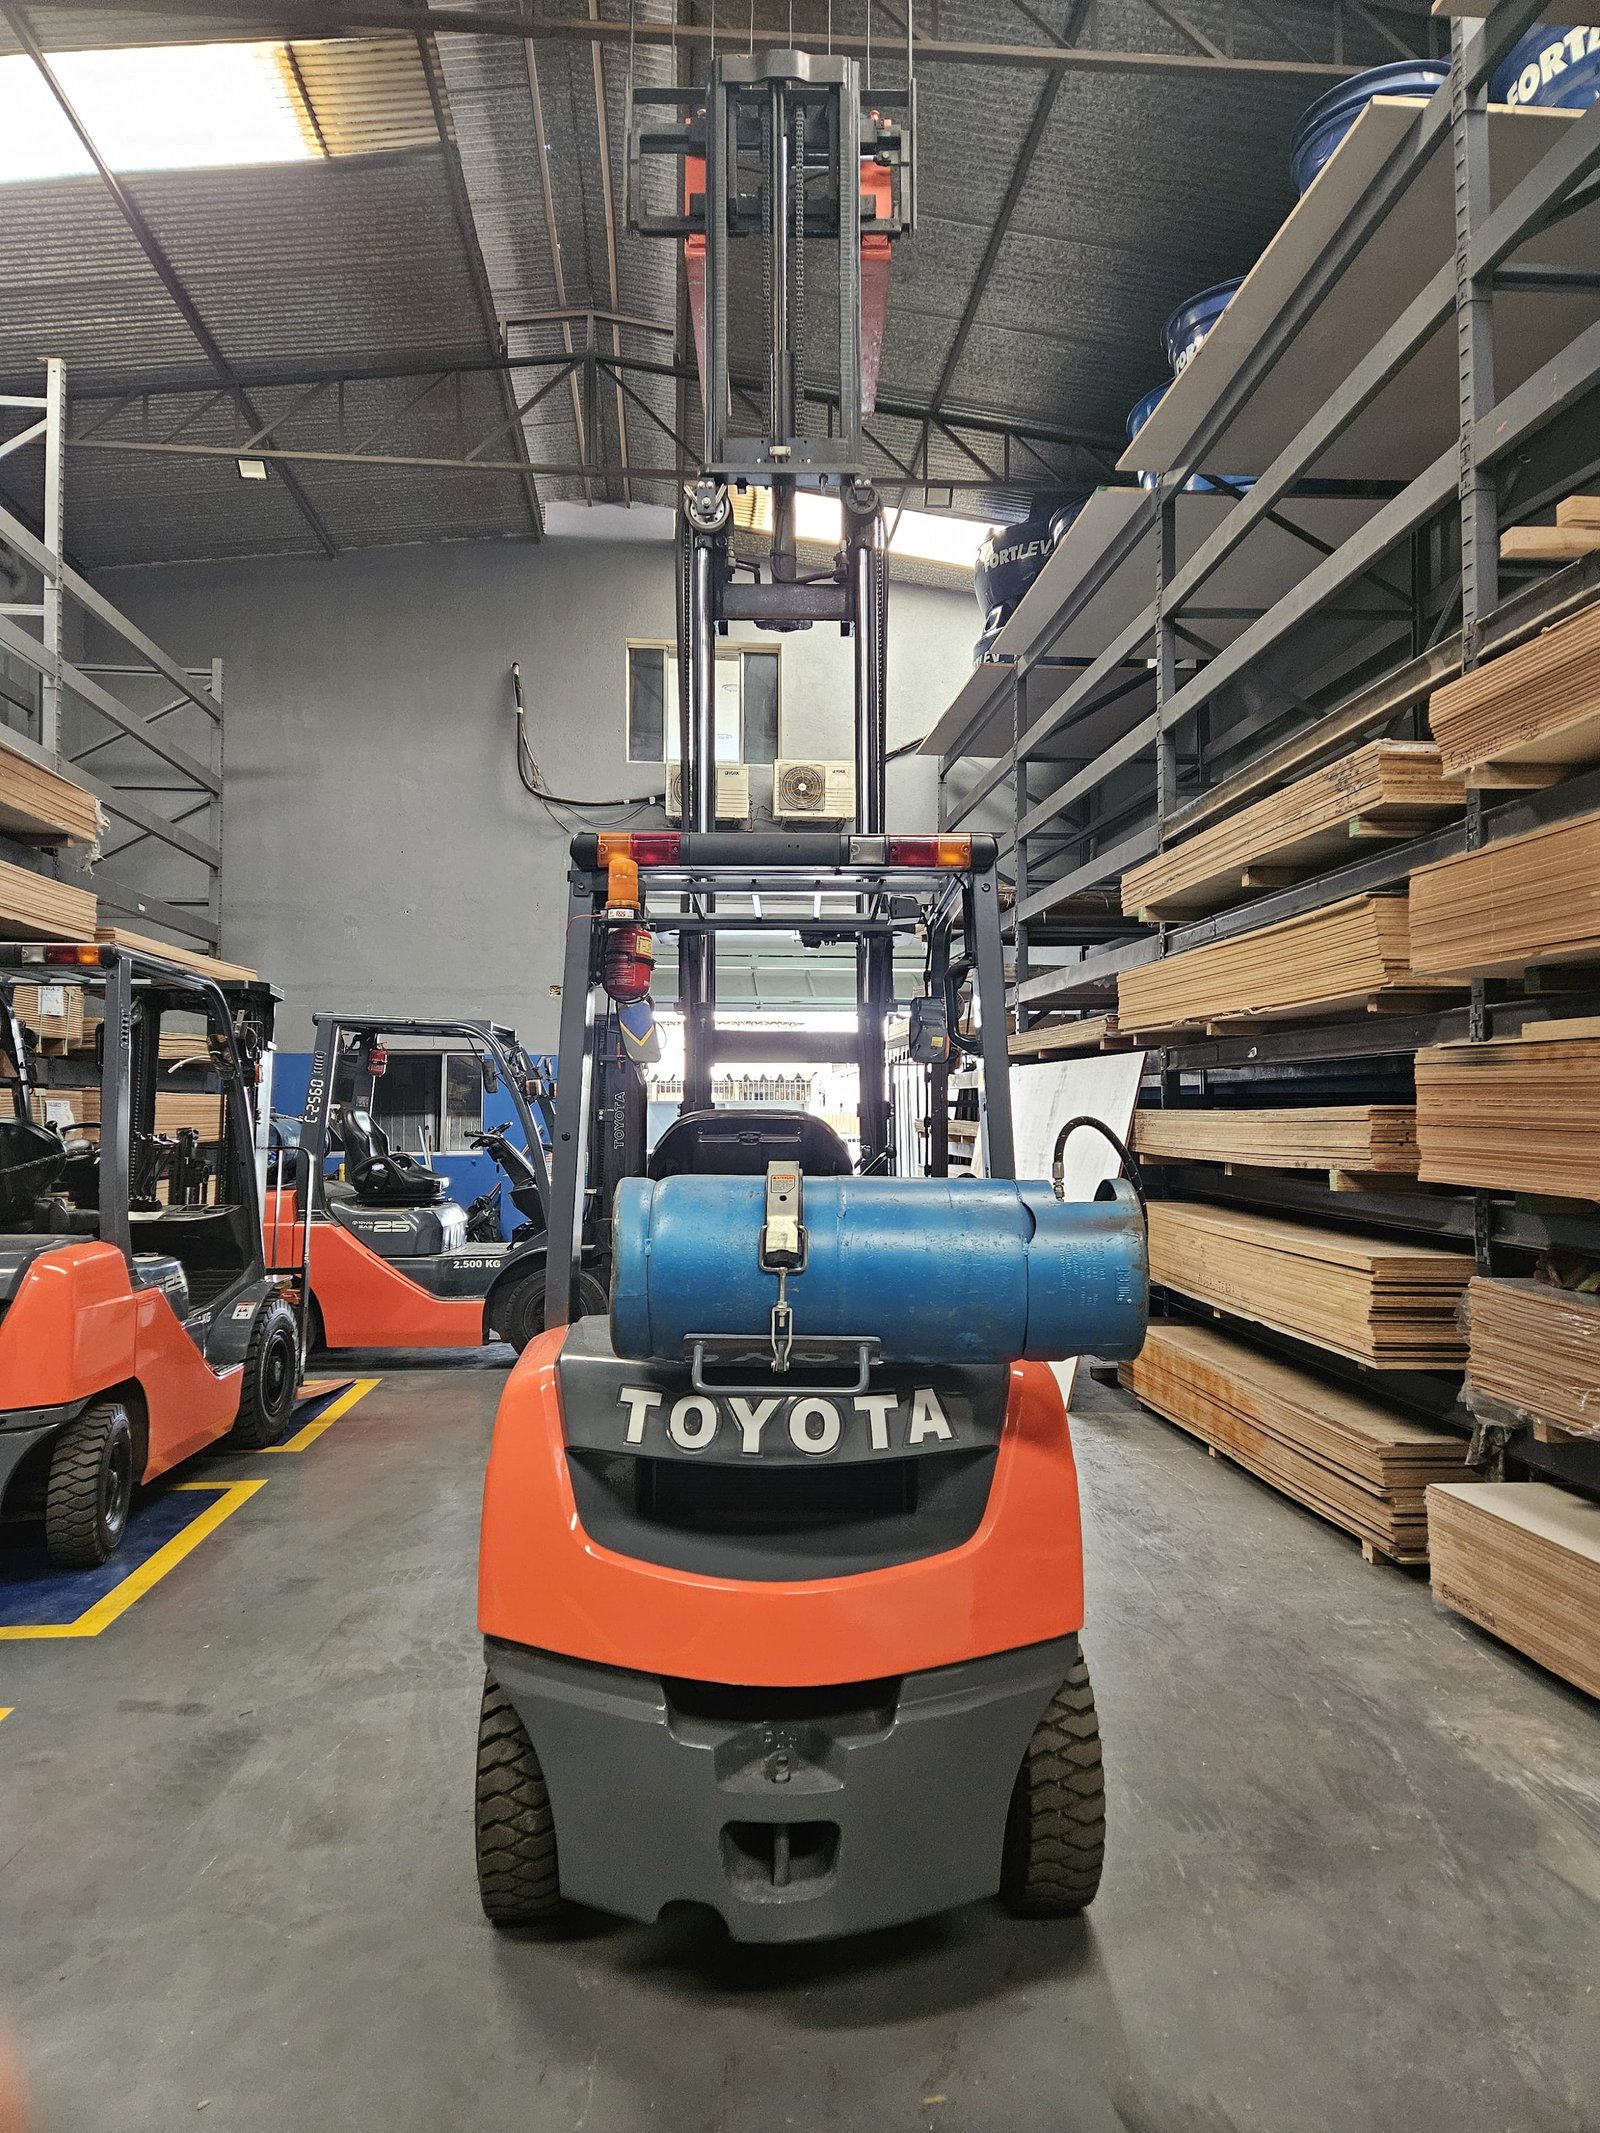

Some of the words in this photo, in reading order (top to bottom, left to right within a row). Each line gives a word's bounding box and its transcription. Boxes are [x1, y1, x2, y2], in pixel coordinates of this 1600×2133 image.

[983, 539, 1053, 573] FORTLEV
[304, 1078, 324, 1124] C-2560
[613, 1091, 626, 1150] TOYOTA
[373, 1220, 411, 1233] 25
[452, 1259, 482, 1269] 2.500
[485, 1259, 501, 1268] KG
[618, 1386, 954, 1455] TOYOTA
